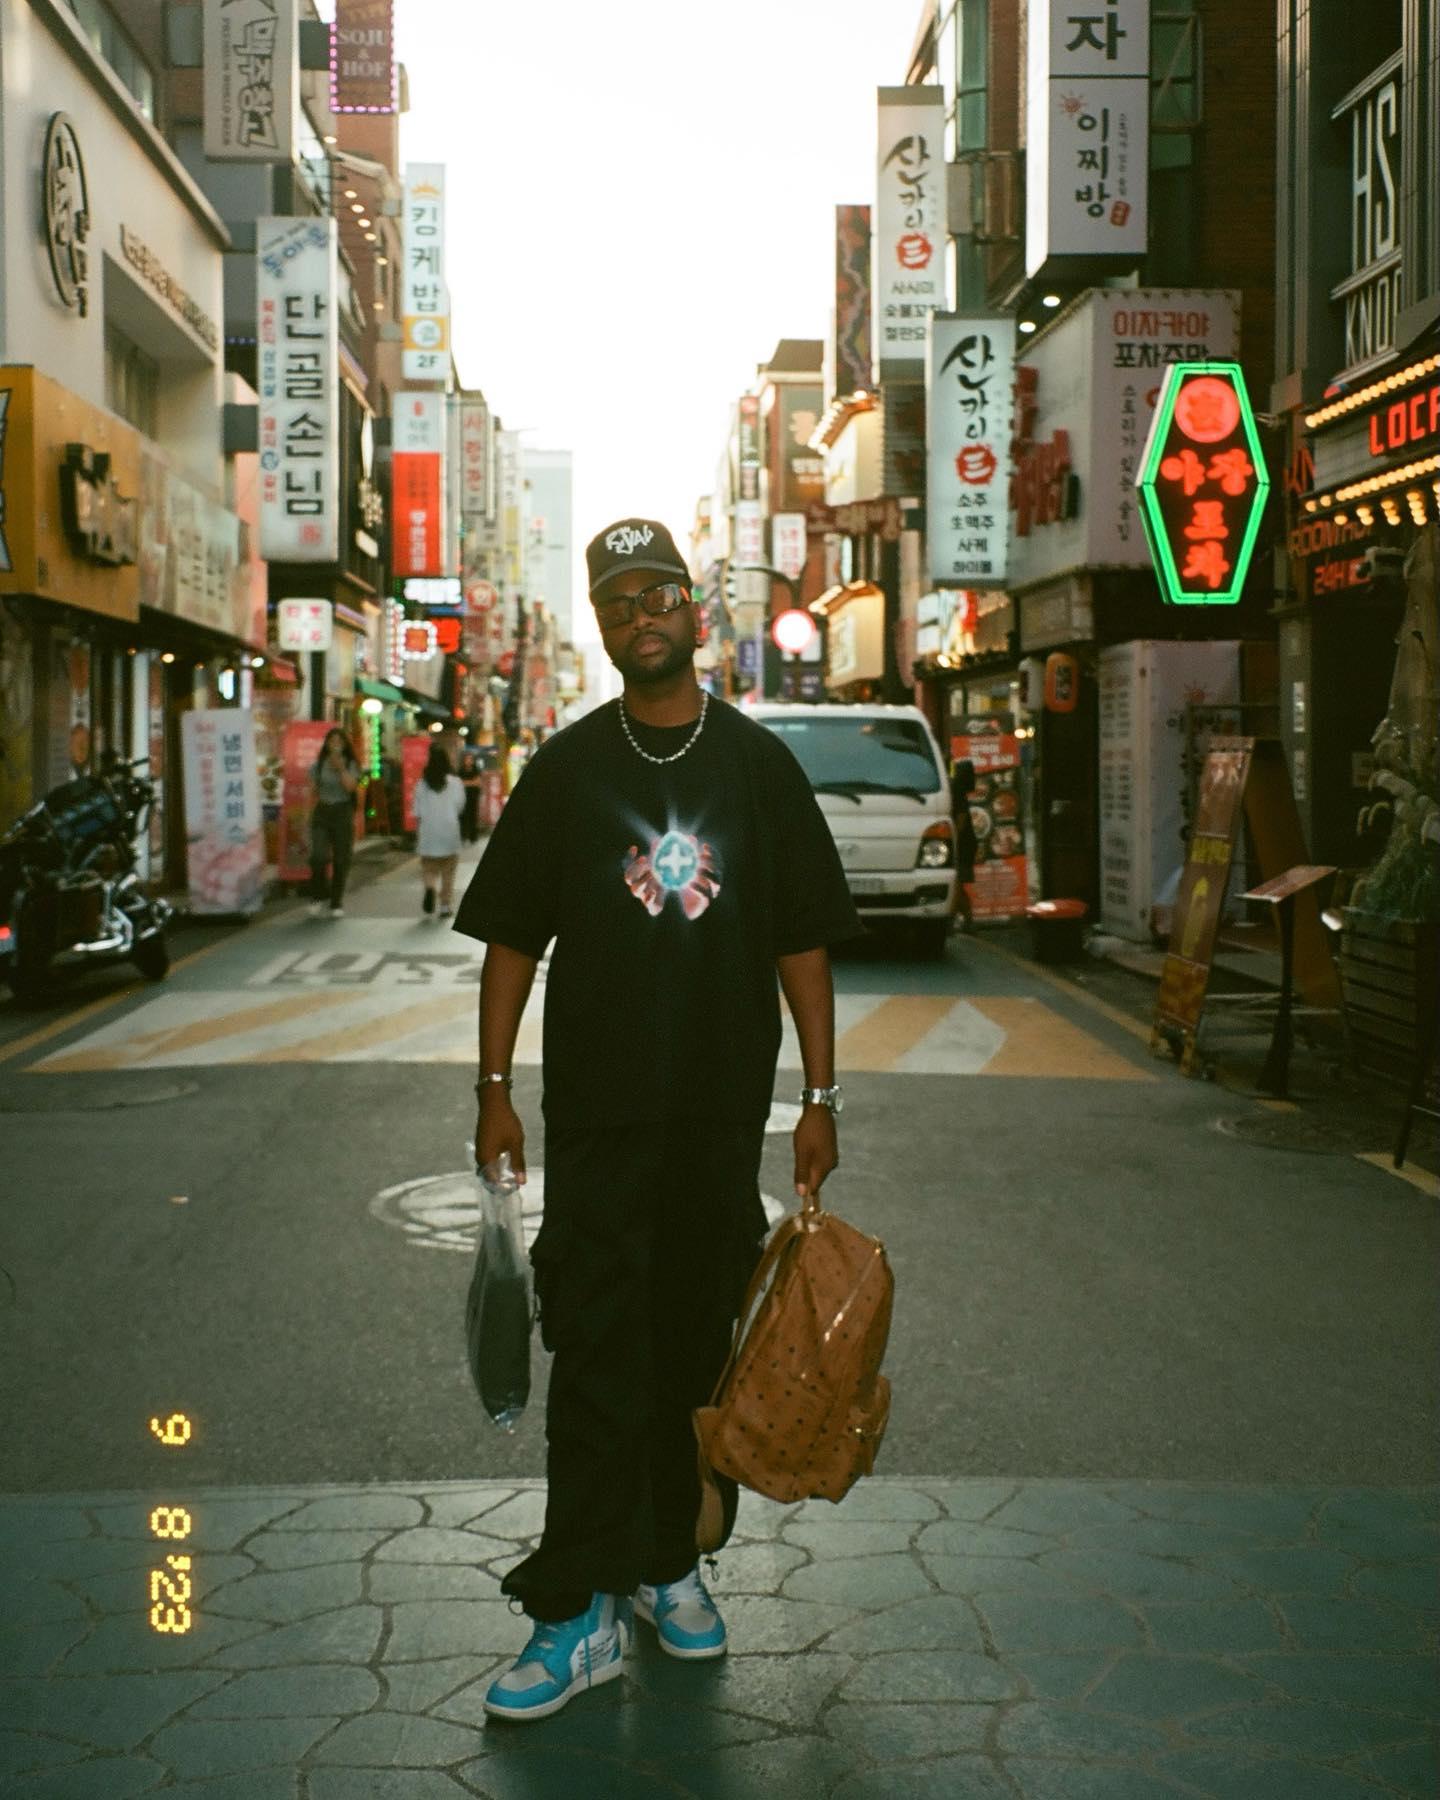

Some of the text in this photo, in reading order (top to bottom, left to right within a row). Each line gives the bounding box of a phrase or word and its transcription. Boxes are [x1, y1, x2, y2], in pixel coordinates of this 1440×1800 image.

[336, 29, 385, 46] SOJU
[1066, 0, 1127, 60] 자
[342, 61, 386, 77] HOF
[1075, 107, 1111, 218] 이찌방
[411, 206, 441, 312] 킹케밥
[884, 326, 926, 341] 철판요
[1113, 309, 1210, 338] 이자카야
[417, 355, 438, 368] 2F
[285, 294, 328, 515] 단골손님
[957, 492, 989, 508] 소주
[956, 535, 989, 553] 사케
[223, 733, 248, 844] 냉면 서비스
